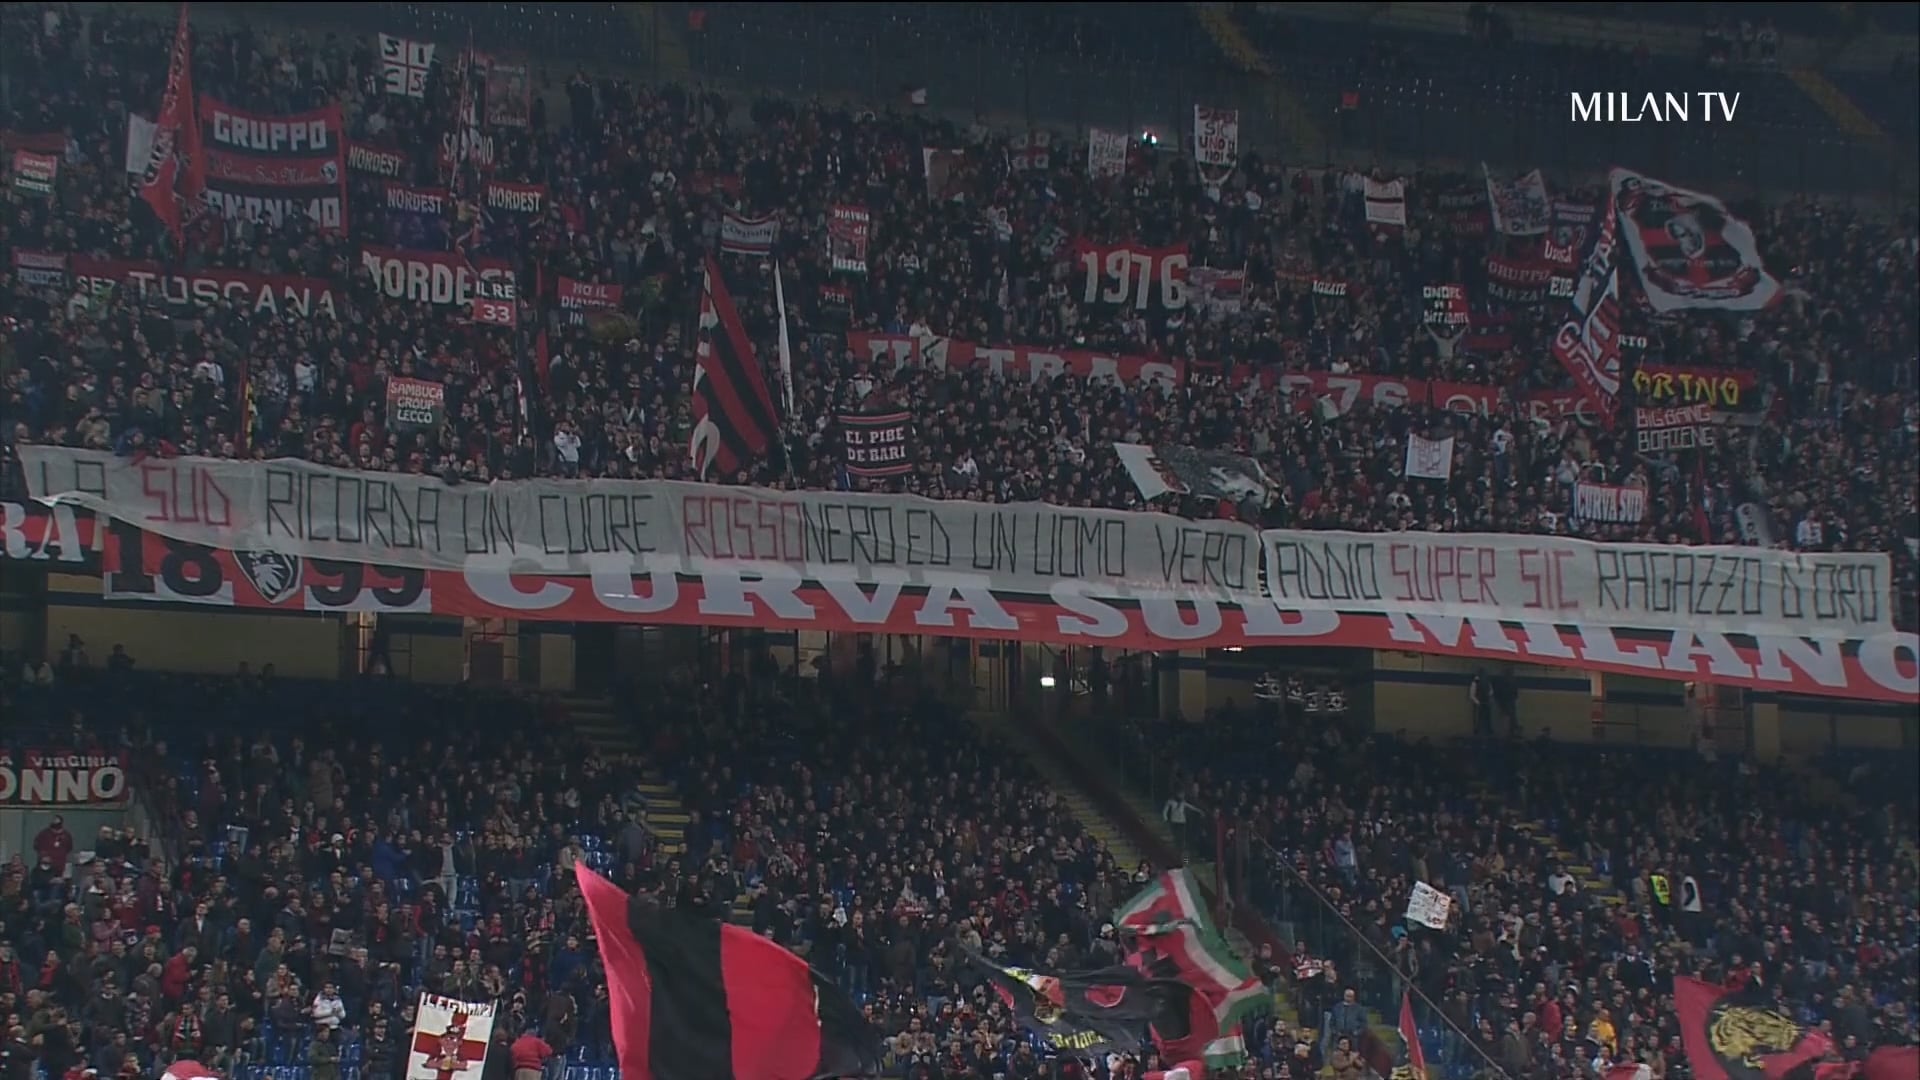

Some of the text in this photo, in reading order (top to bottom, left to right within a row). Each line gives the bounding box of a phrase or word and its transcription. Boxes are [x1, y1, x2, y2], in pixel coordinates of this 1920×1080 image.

[213, 110, 327, 151] GRUPPO
[348, 146, 402, 176] NORDEST
[387, 188, 442, 214] NORDEST
[487, 185, 542, 213] NORDEST
[362, 250, 514, 306] NORDE
[476, 280, 513, 299] IL RE
[1081, 250, 1188, 309] 1976
[128, 270, 338, 321] TOSCANA
[483, 304, 511, 322] 33
[390, 382, 444, 400] SAMBUCA
[397, 397, 435, 410] GROUP
[397, 410, 433, 423] LECCO
[845, 427, 904, 444] EL PIBE
[847, 445, 906, 462] DE BARI
[1578, 484, 1644, 522] CURVA SUD
[41, 460, 107, 500] LA
[142, 466, 230, 527] SUD
[266, 468, 441, 552] RICORDA
[463, 495, 516, 555] UN
[539, 494, 656, 555] CUORE
[906, 509, 951, 566] ED
[973, 511, 1017, 574] UN
[1034, 511, 1126, 578] UOMO
[1155, 522, 1247, 590] VERO
[1276, 542, 1382, 600] ADDIO
[1390, 543, 1499, 606] SUPER
[1518, 549, 1579, 608] SIC
[1596, 549, 1763, 616] RAGAZZO
[1781, 554, 1878, 625] D'ORO
[463, 543, 1020, 631] CURVA
[1049, 579, 1342, 642] SUD
[1388, 608, 1918, 694] MILANO
[31, 754, 119, 768] VIRGINIA
